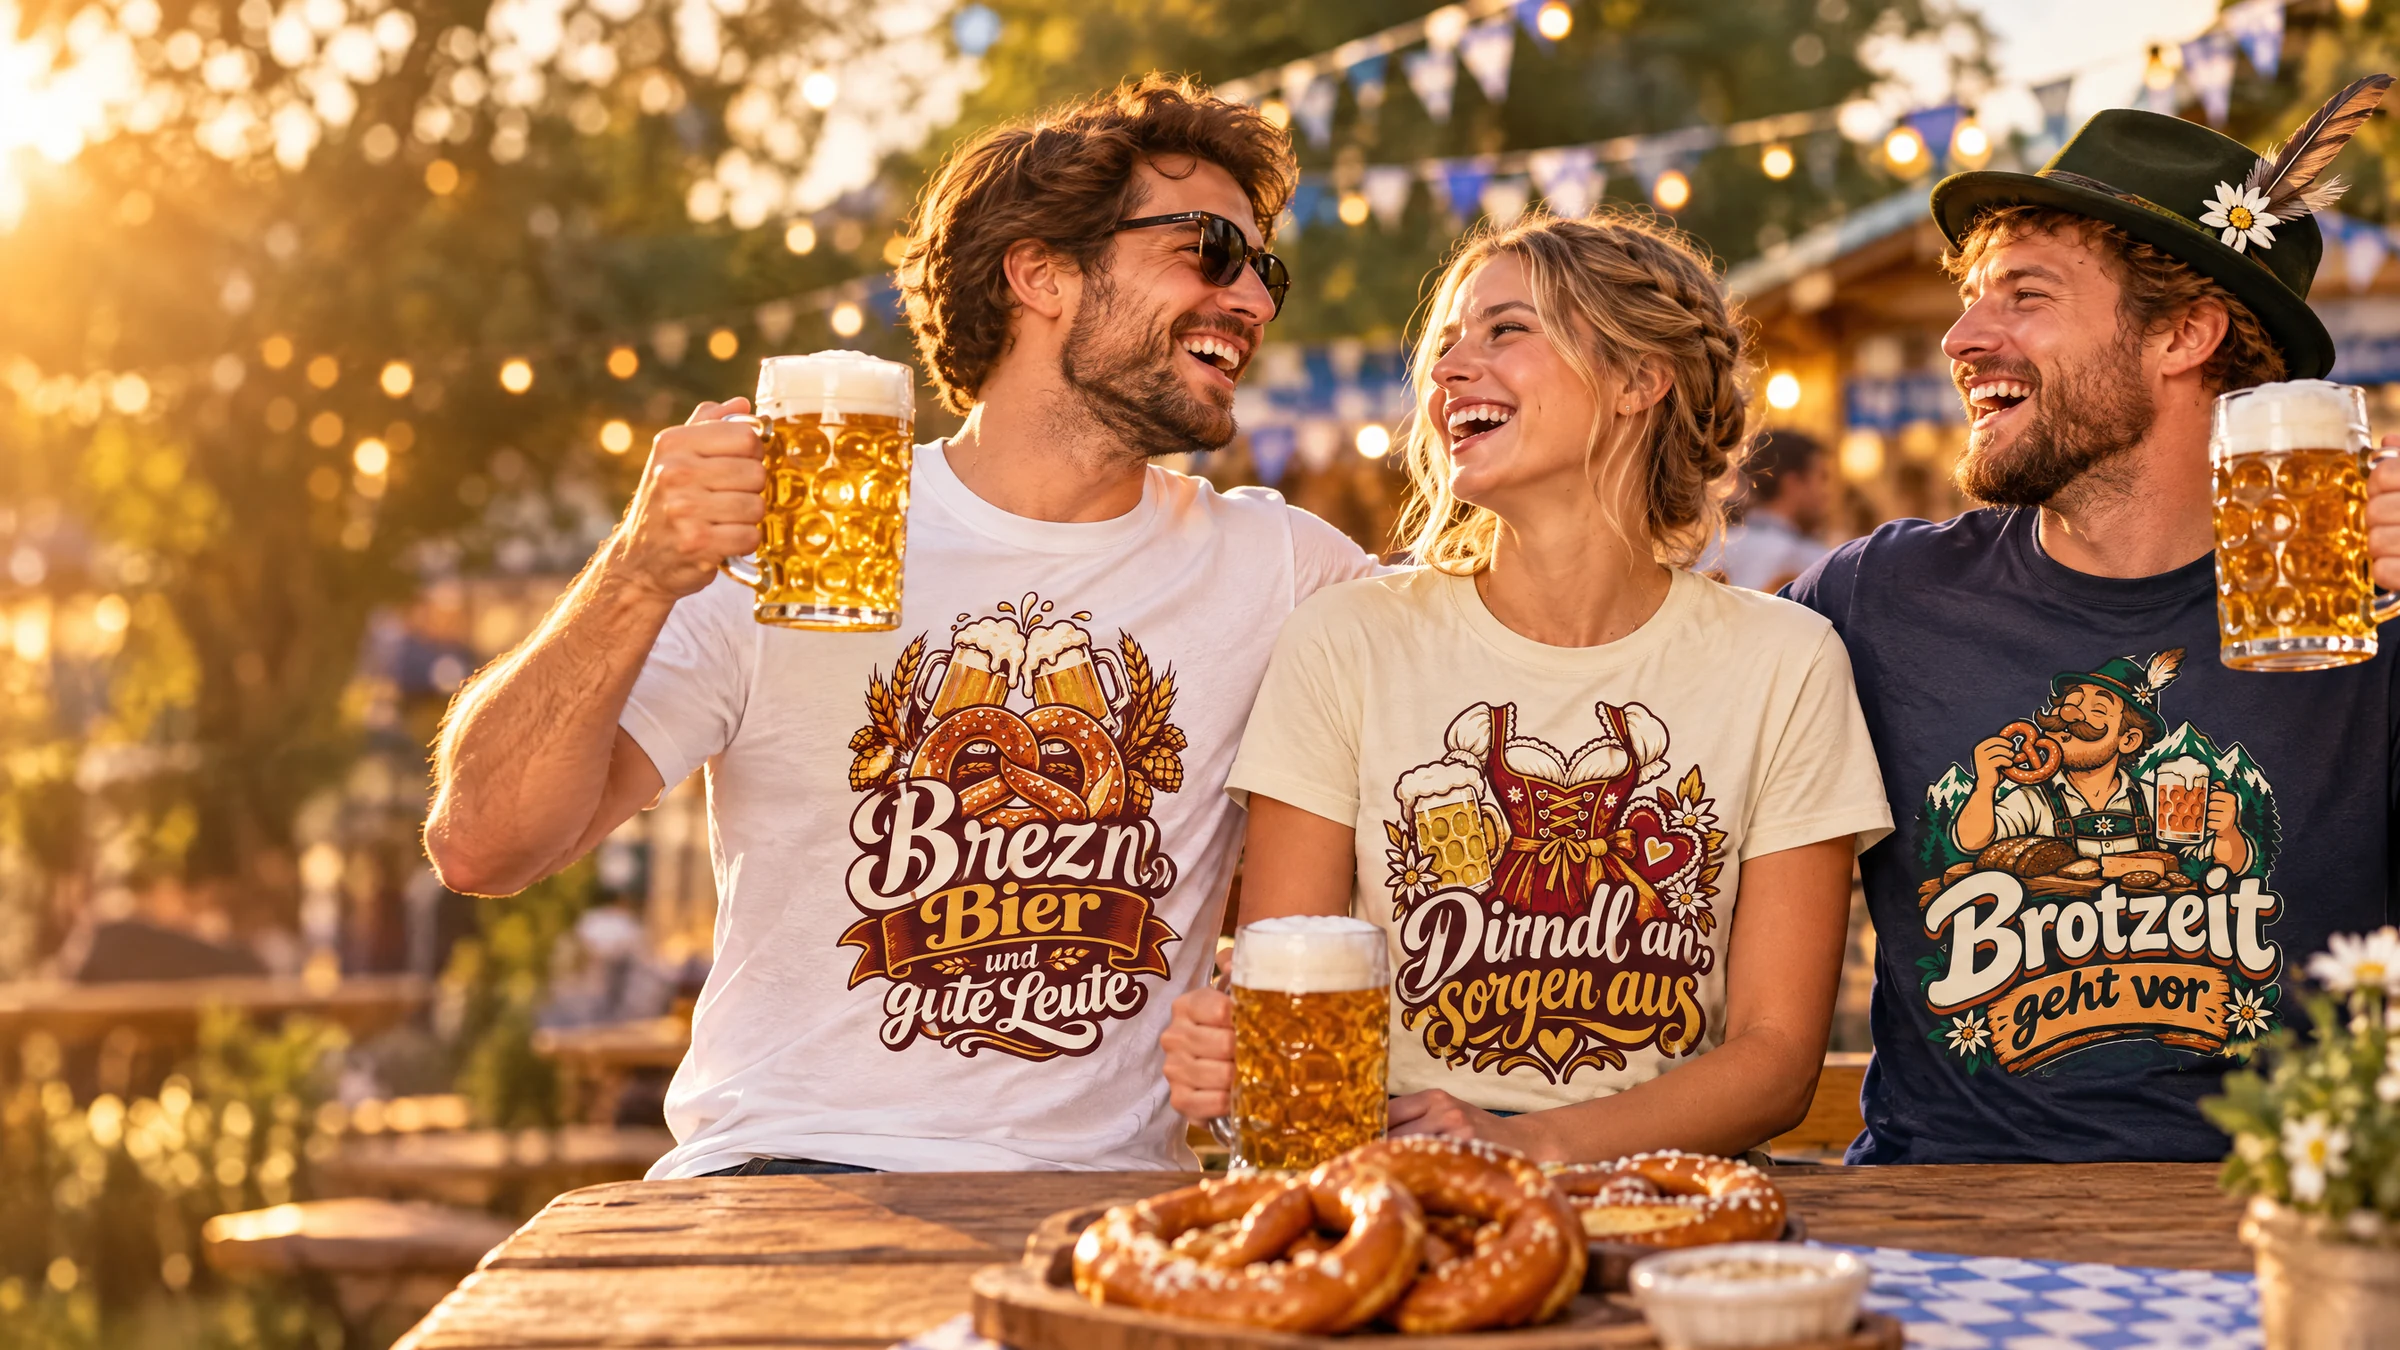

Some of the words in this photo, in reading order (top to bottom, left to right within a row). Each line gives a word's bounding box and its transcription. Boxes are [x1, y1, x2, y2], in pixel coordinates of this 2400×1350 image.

[920, 882, 1101, 950] Bier
[1400, 883, 1635, 1004] Dirndl
[1640, 921, 1711, 969] an,
[1925, 867, 2276, 1007] Brotzeit
[985, 943, 1039, 973] und
[880, 974, 998, 1045] gute
[999, 964, 1141, 1050] Leute
[1606, 971, 1701, 1054] aus
[2012, 967, 2121, 1050] geht
[2130, 975, 2209, 1012] vor
